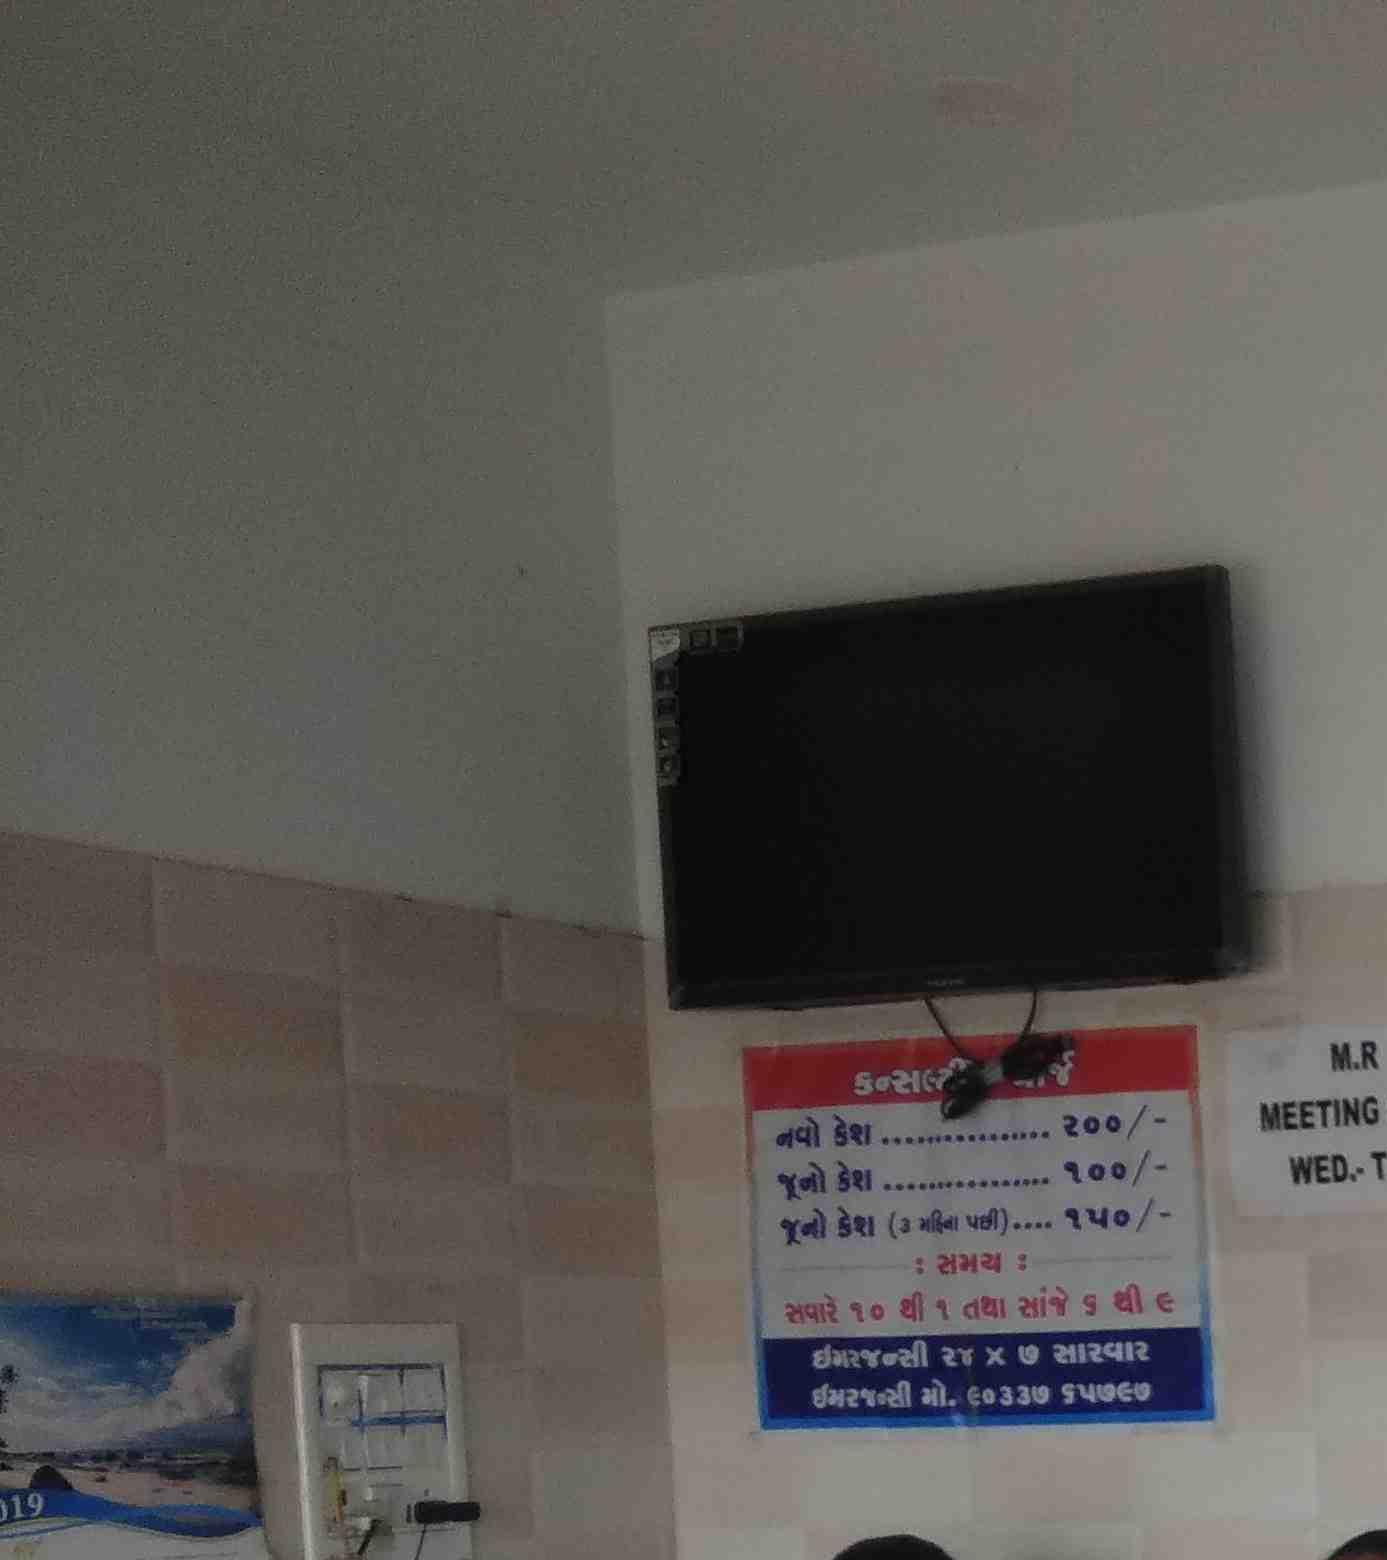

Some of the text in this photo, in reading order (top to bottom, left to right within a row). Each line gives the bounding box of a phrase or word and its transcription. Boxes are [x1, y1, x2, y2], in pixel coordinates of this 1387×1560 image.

[1330, 1041, 1379, 1071] M.R
[776, 1116, 820, 1148] નવો
[1063, 1104, 1167, 1141] ૨૦૦/-
[1259, 1096, 1379, 1132] MEETING
[777, 1161, 826, 1200] જૂનો
[1063, 1150, 1168, 1188] ૧૦૦/-
[780, 1208, 827, 1246] જૂનો
[1064, 1198, 1172, 1232] ૧૫૦/-
[936, 1251, 1003, 1275] સમય
[784, 1293, 838, 1323] સવારે
[850, 1302, 885, 1322] ૧૦
[900, 1291, 925, 1322] થી
[936, 1299, 949, 1320] ૧
[963, 1296, 1007, 1321] તથા
[1018, 1285, 1068, 1318] સાંજે
[1113, 1283, 1143, 1314] થી
[1156, 1291, 1175, 1313] ૯
[942, 1346, 974, 1366] ૨૪
[1018, 1344, 1040, 1365] ૭
[1053, 1341, 1150, 1365] સારવાર
[921, 1379, 956, 1407] મો.
